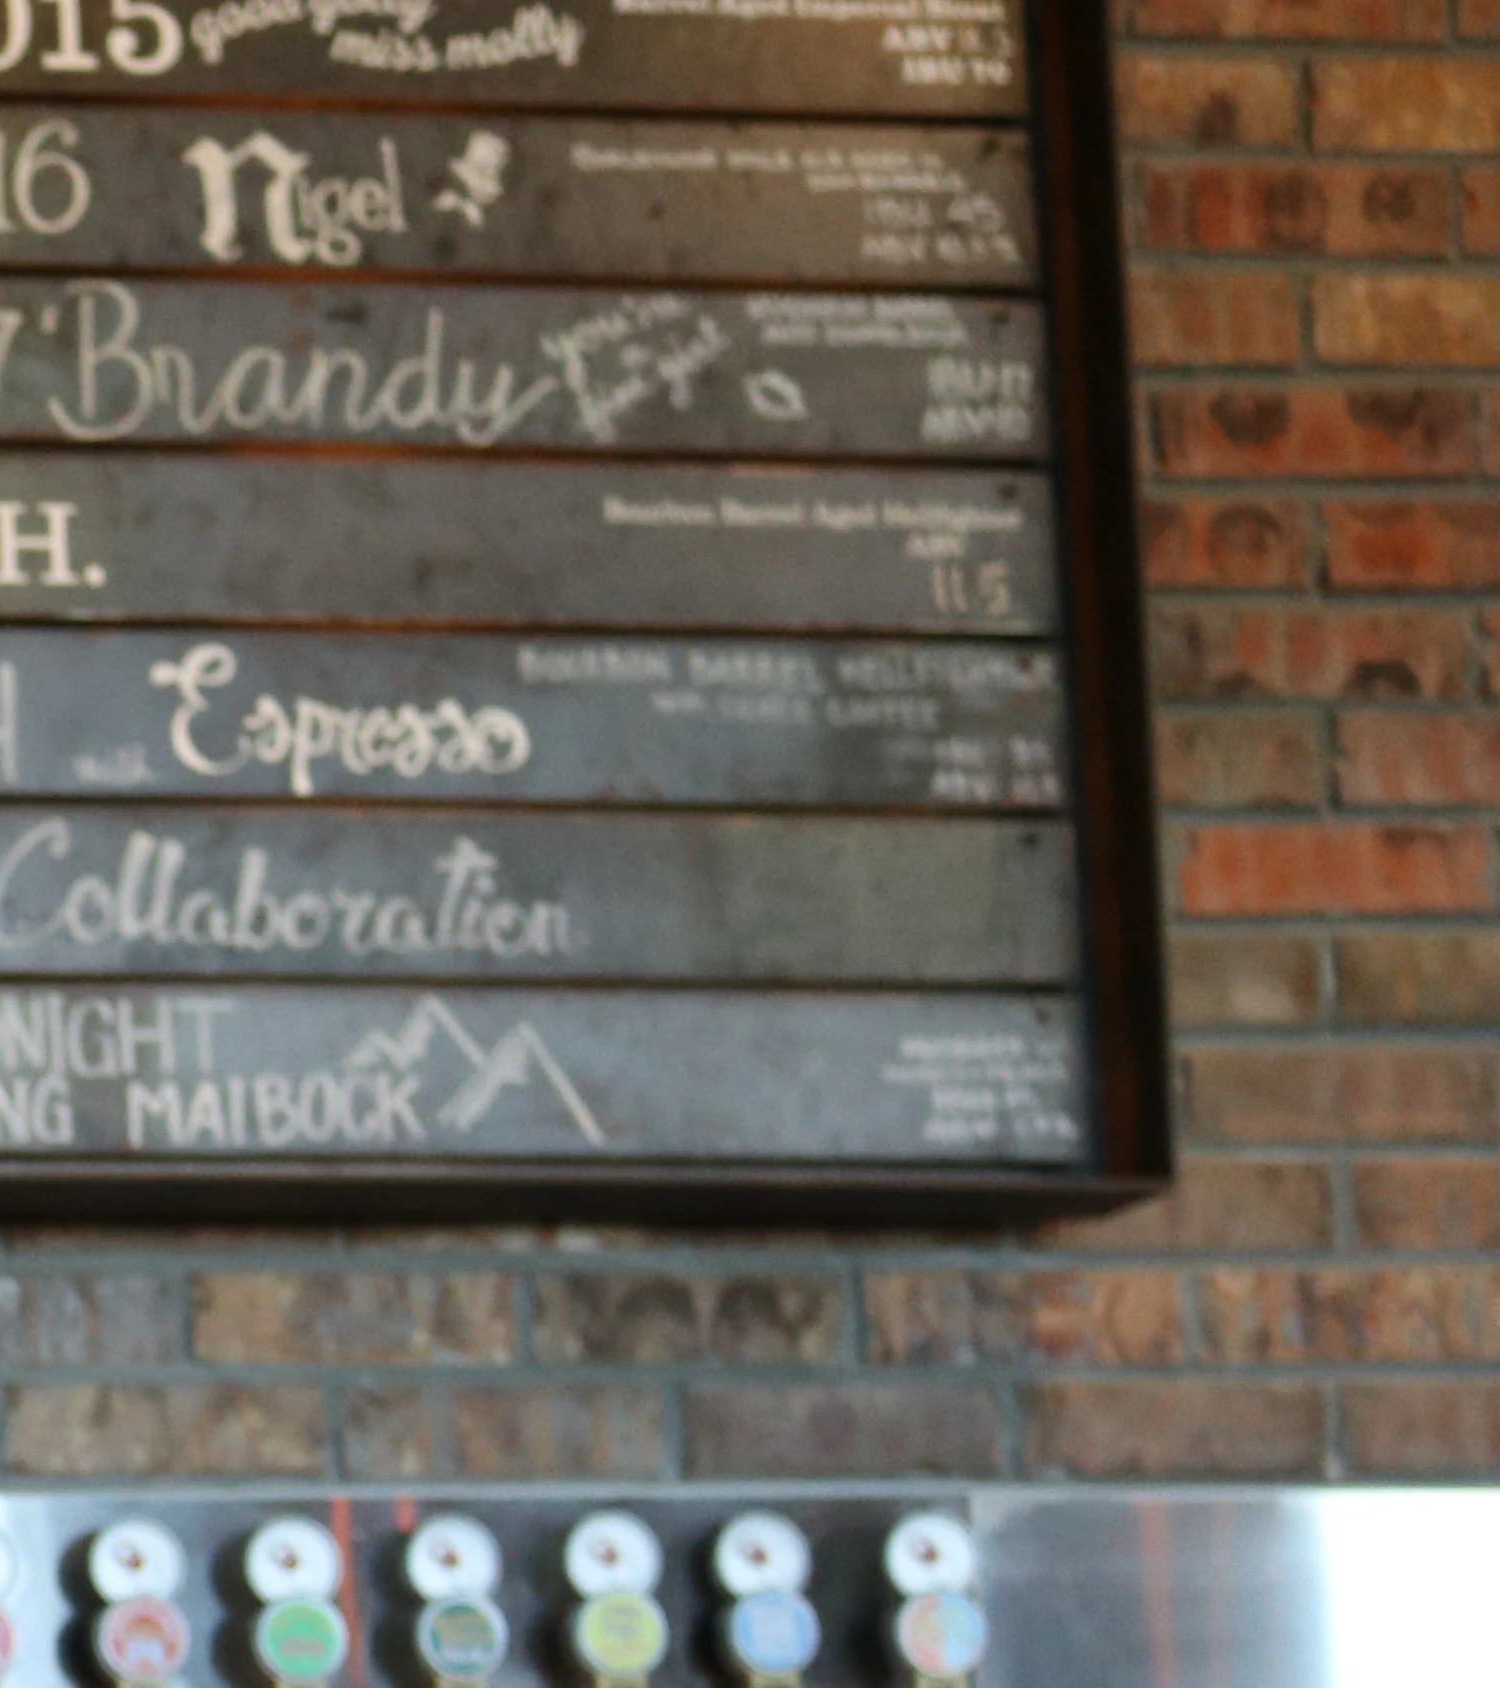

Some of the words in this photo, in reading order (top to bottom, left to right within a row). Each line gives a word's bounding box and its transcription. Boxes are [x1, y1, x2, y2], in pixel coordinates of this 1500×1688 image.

[47, 279, 562, 447] Brandy
[149, 641, 532, 798] Espresso
[127, 1070, 430, 1151] MAIBOCK
